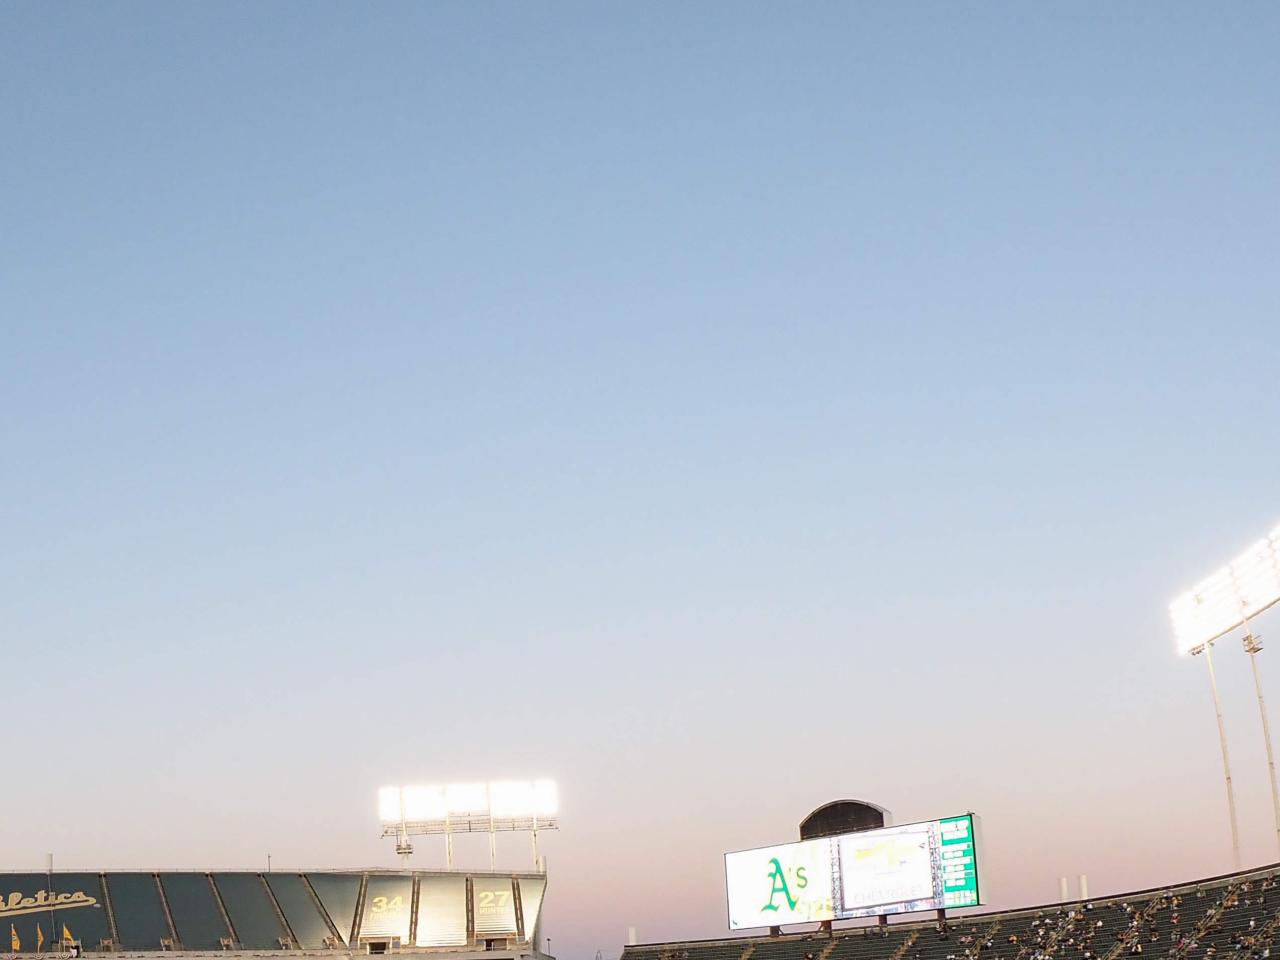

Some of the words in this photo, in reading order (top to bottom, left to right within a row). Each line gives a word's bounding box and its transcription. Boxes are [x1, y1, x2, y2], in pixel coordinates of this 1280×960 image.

[761, 858, 808, 912] A's
[372, 896, 403, 912] 34
[479, 891, 510, 907] 27
